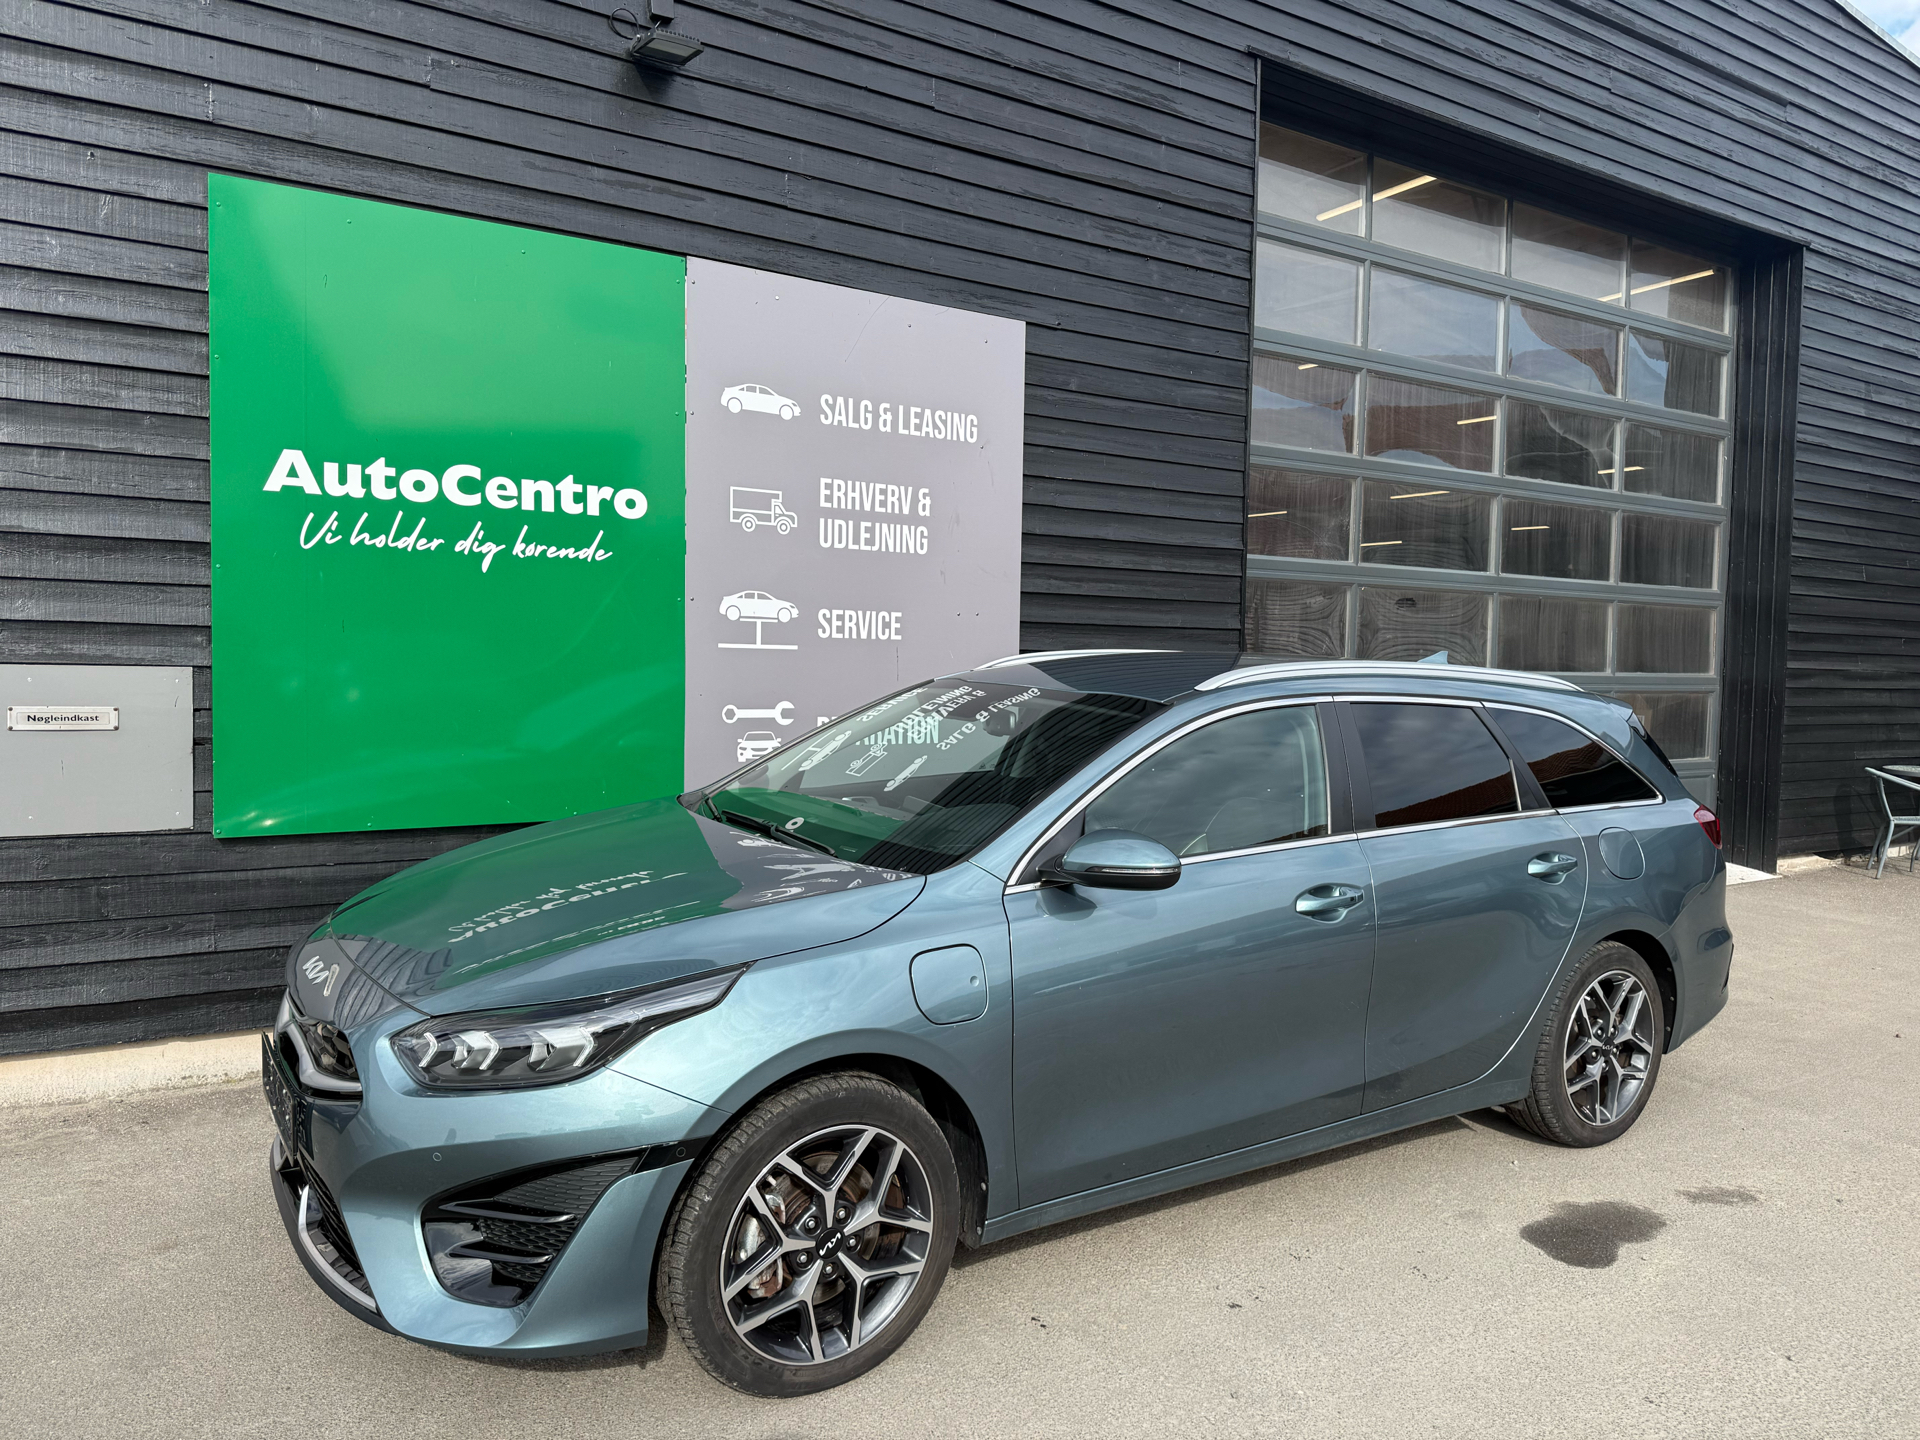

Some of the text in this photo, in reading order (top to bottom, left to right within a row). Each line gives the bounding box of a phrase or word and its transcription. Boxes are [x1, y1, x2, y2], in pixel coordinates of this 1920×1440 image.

[819, 393, 978, 443] SALG & LEASING
[262, 448, 648, 519] AutoCentro
[819, 477, 931, 517] ERHVERV &
[300, 510, 613, 573] Vi holder dig kørende
[819, 518, 928, 555] UDLEJNING
[817, 608, 902, 641] SERVICE
[27, 714, 100, 724] Nøgleindkast
